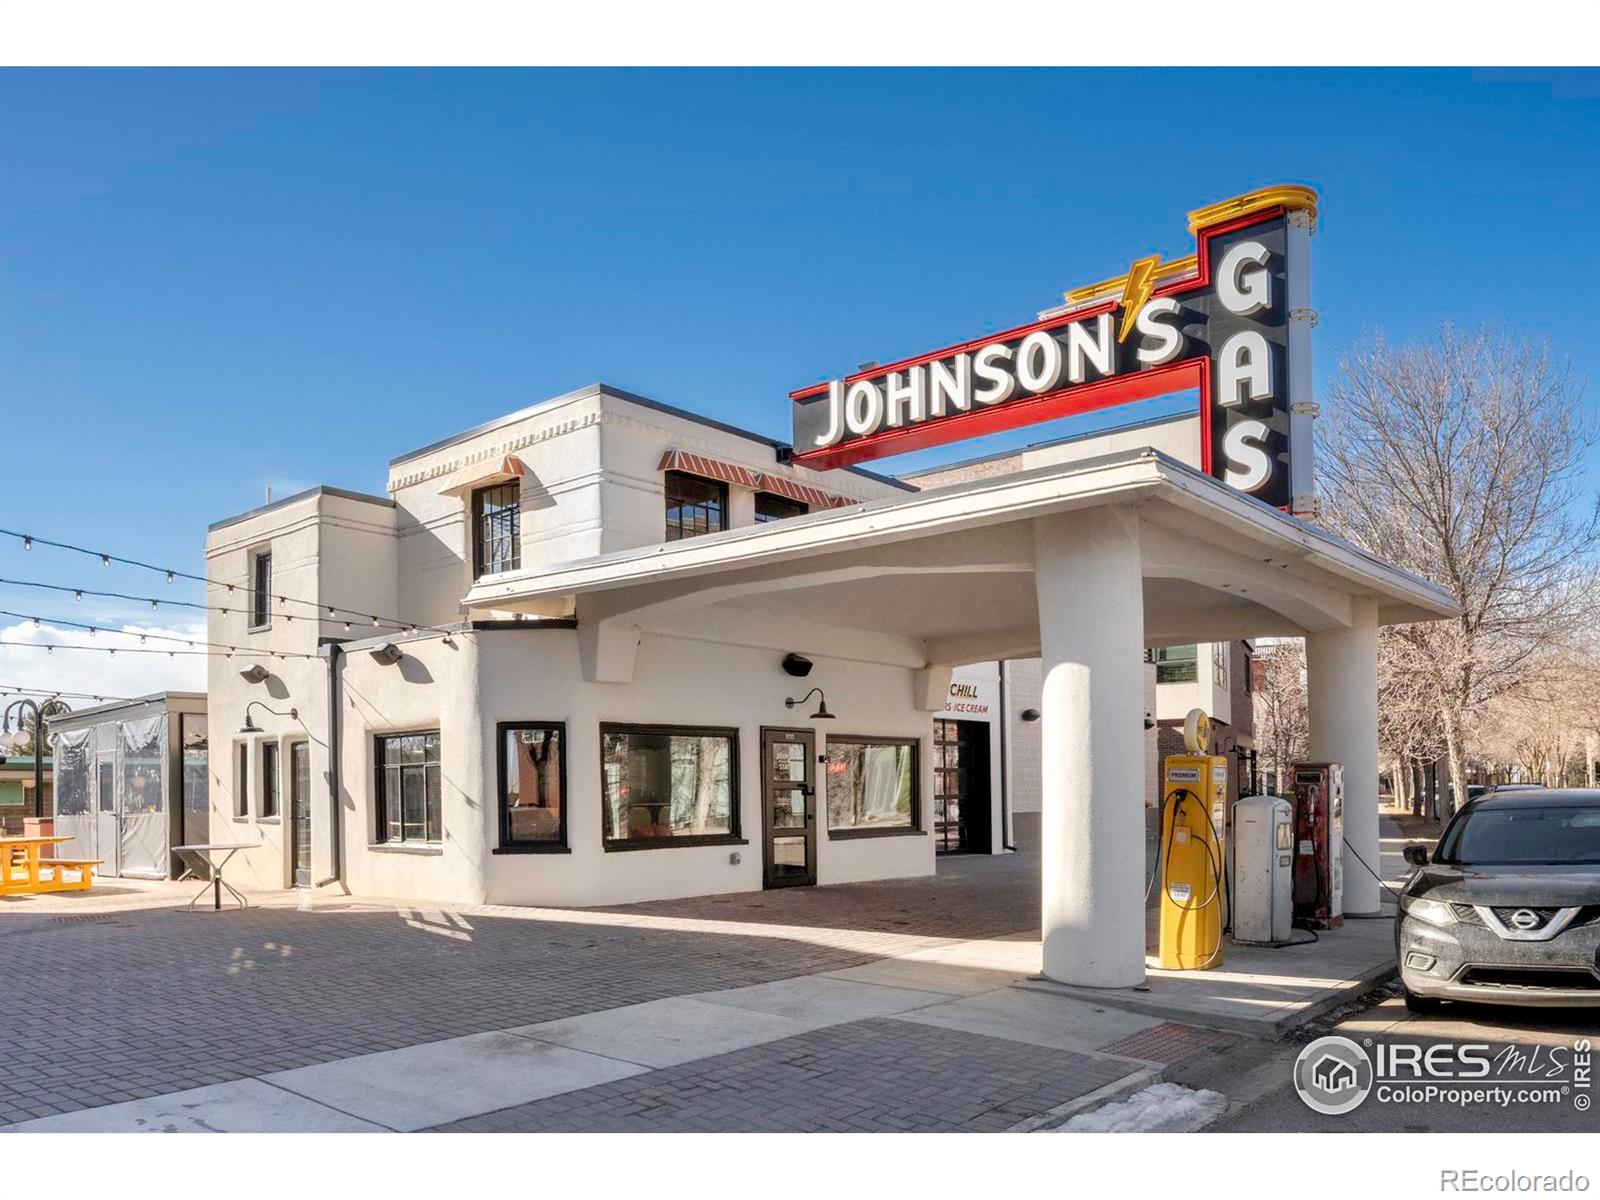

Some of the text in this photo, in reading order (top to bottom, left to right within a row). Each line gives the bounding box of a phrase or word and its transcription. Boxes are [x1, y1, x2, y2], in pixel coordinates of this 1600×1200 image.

[815, 255, 1184, 446] JOHNSON'S
[1216, 241, 1273, 493] GAS
[950, 683, 977, 698] CHILL
[953, 703, 965, 712] ICE
[965, 703, 989, 713] CREAM
